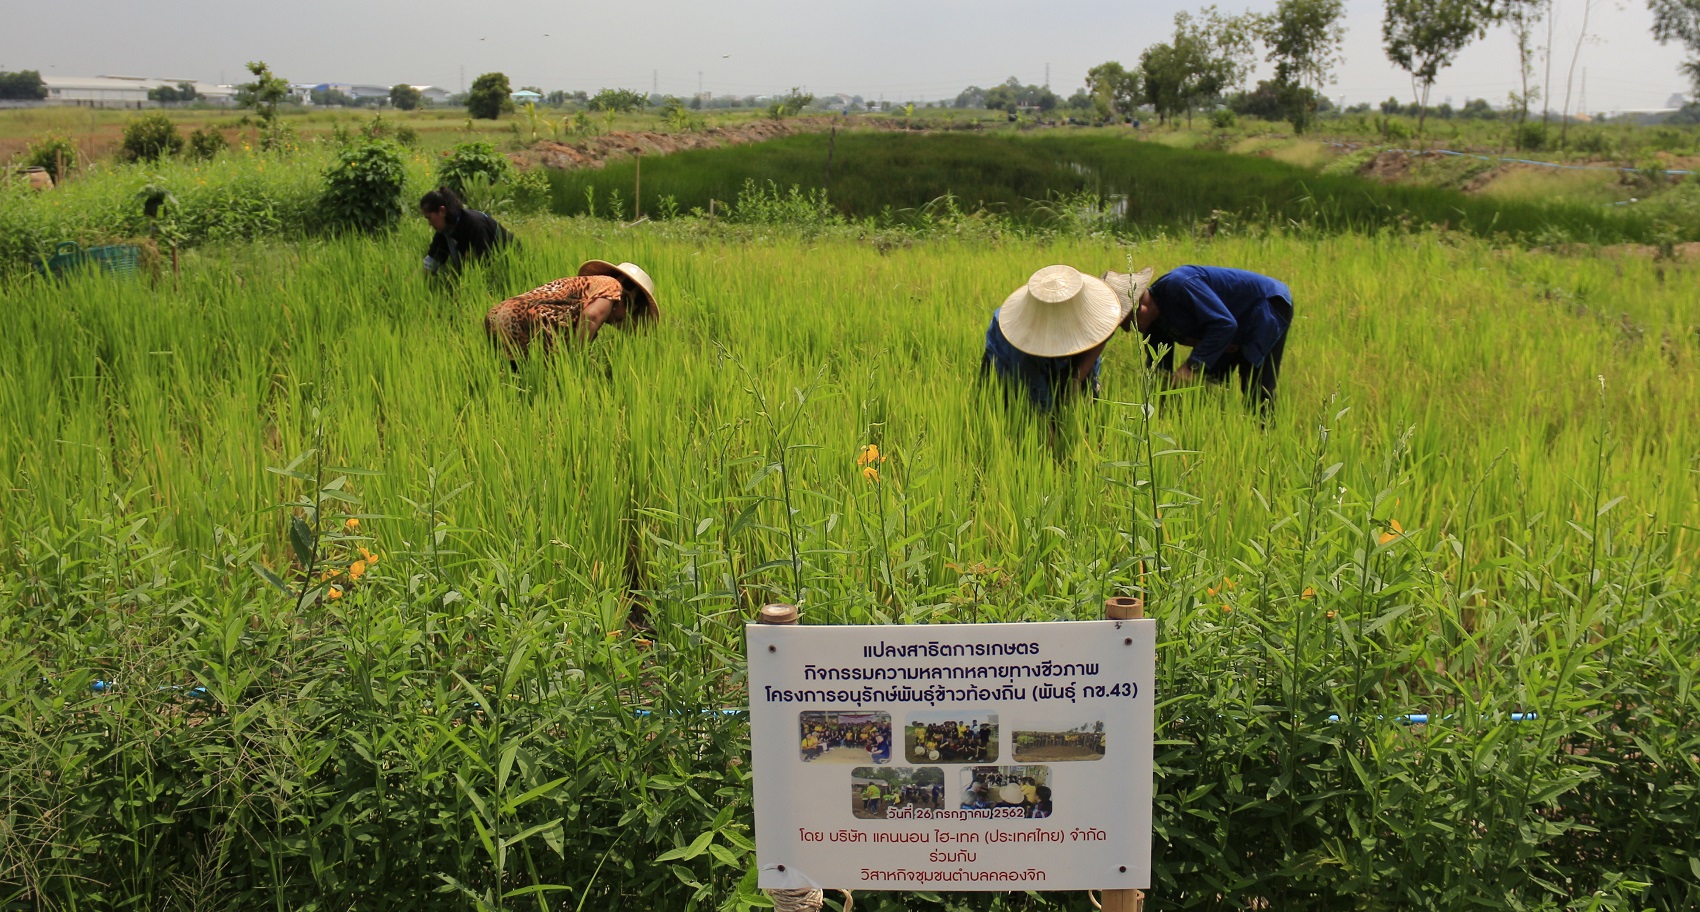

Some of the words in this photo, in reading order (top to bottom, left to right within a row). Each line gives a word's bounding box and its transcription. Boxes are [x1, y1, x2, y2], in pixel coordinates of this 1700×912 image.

[863, 640, 1040, 658] แปลงสาธิตการเกษตร
[804, 660, 1099, 681] กิจกรรมความหลากหลายทางชีวภาพ
[764, 679, 1026, 707] โครงการอนุรักษ์พันธุ์ข้าวท้องถิ่น
[1032, 682, 1077, 703] (พันธุ์
[1083, 682, 1138, 699] กข.43)
[888, 804, 912, 819] วันที่
[916, 809, 931, 819] 26
[935, 809, 990, 821] กรกฎาคม
[993, 808, 1024, 818] 2562
[799, 828, 824, 842] โดย
[829, 828, 867, 843] บริษัท
[873, 832, 930, 843] แคนนอน
[934, 828, 979, 843] ไฮ-เทค
[984, 828, 1065, 844] (ประเทศไทย)
[1070, 827, 1107, 842] จำกัด
[929, 848, 977, 863] ร่วมกับ
[861, 867, 1046, 885] วิสาหกิจชุมชนตำบลคลองจิก
